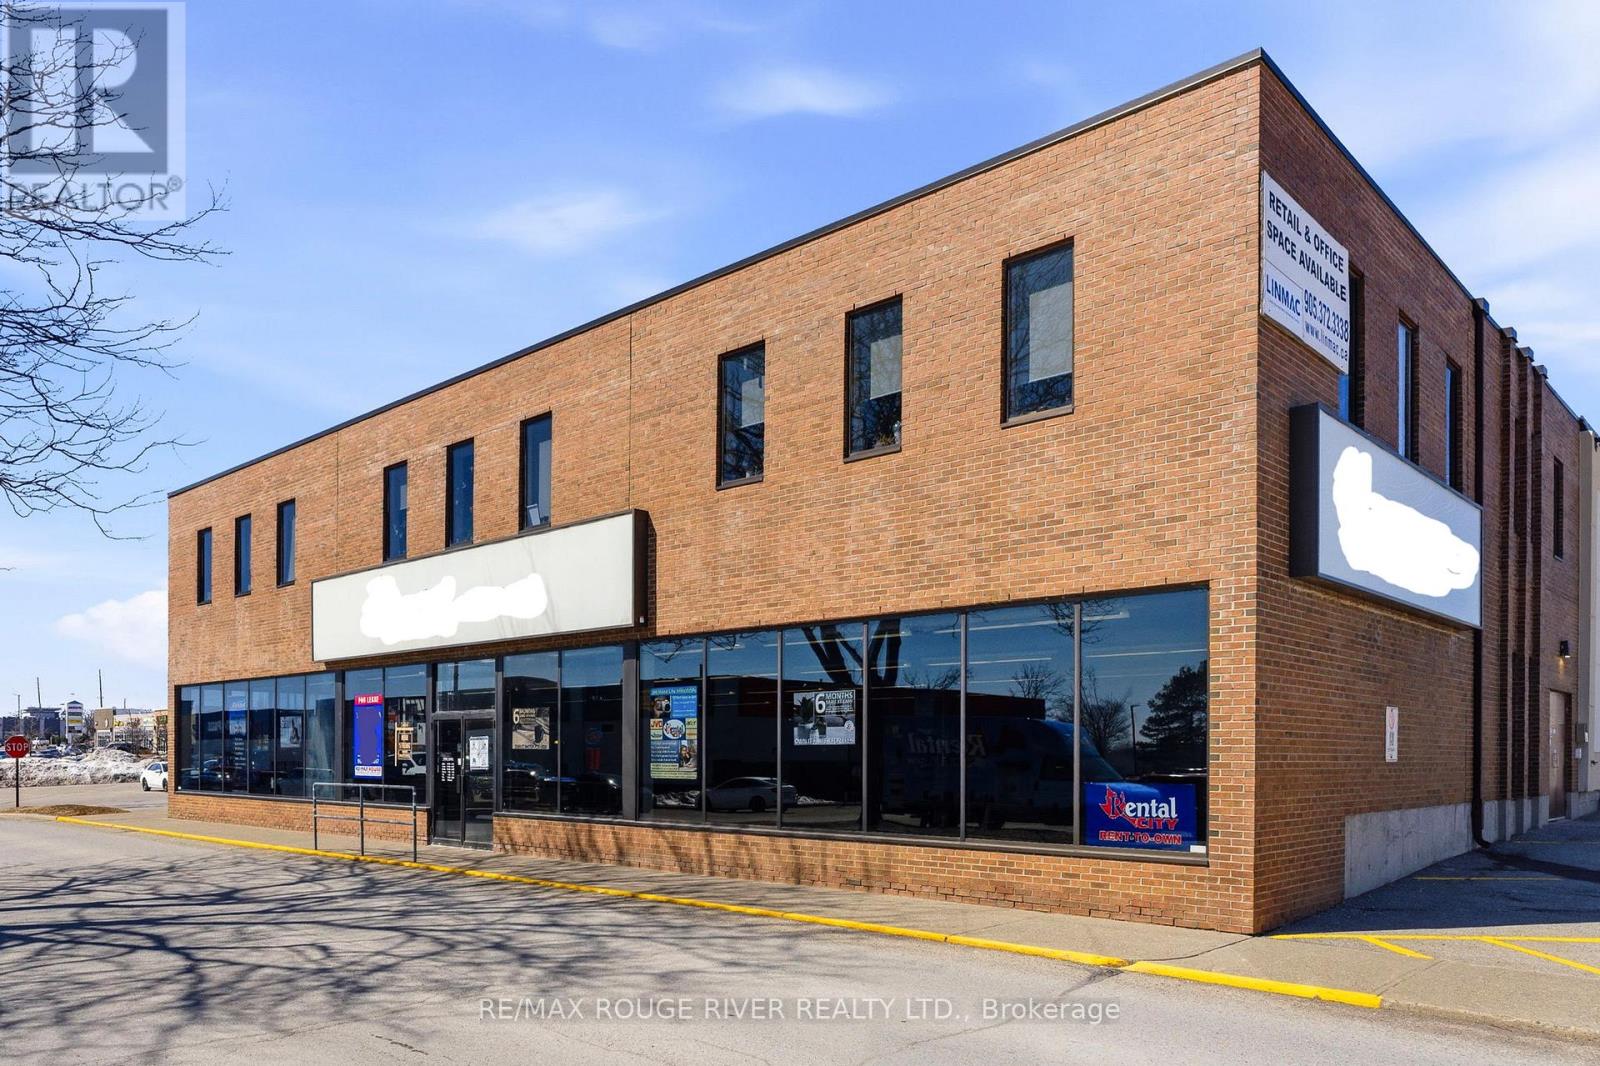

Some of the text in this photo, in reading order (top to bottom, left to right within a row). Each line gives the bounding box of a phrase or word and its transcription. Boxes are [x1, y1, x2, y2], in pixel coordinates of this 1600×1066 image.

[1269, 190, 1344, 274] RETAIL & OFFICE
[1267, 219, 1347, 303] SPACE AVAILABLE
[1266, 274, 1301, 317] LINMAC
[815, 693, 826, 714] 6
[512, 708, 520, 724] 6
[6, 743, 29, 751] STOP
[1108, 796, 1178, 819] Rental
[1136, 817, 1180, 830] CITY
